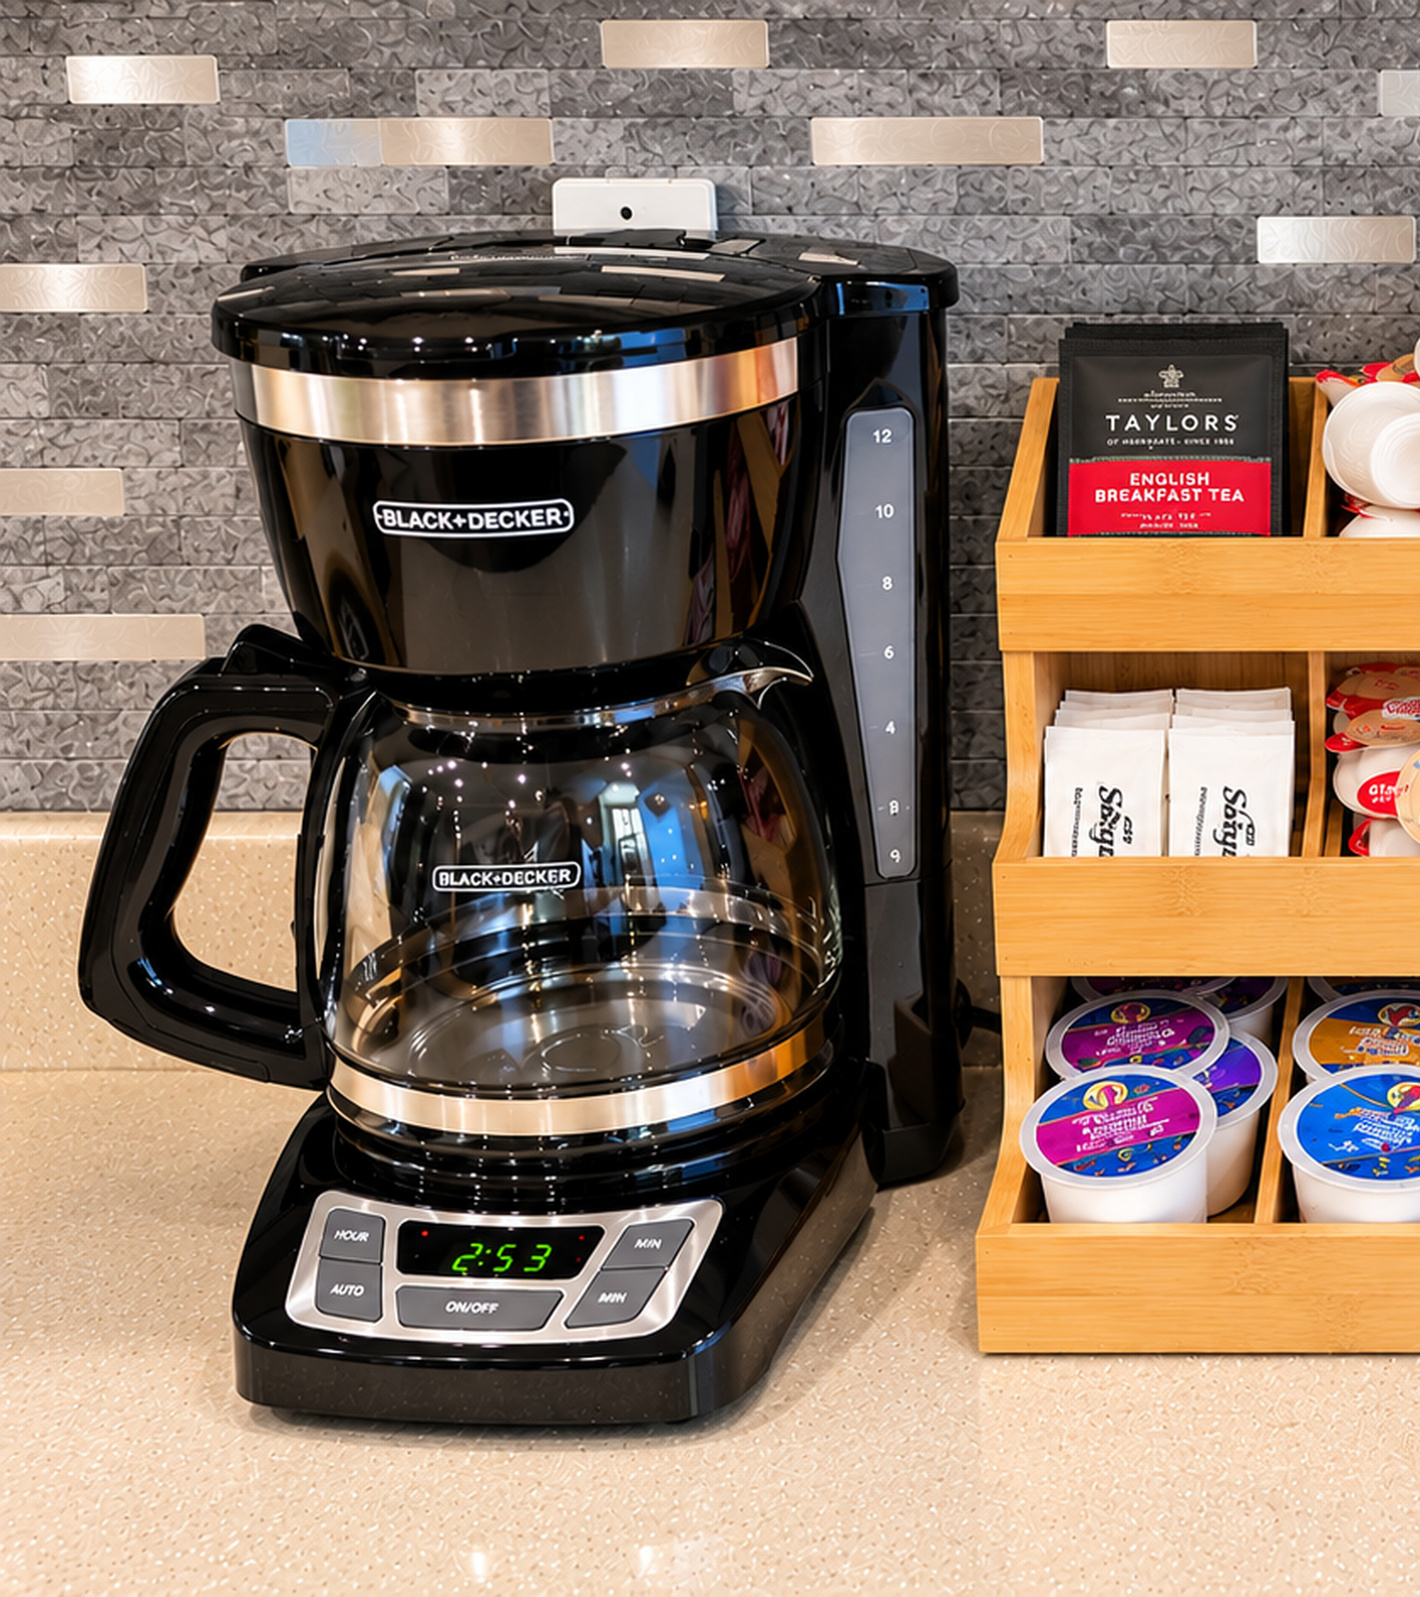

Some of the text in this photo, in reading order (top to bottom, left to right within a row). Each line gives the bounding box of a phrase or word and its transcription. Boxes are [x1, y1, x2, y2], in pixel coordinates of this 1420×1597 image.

[1105, 414, 1238, 431] TAYLORS
[872, 429, 892, 443] 12
[1130, 472, 1209, 486] ENGLISH
[1095, 488, 1244, 503] BREAKFAST TEA
[875, 504, 894, 518] 10
[382, 507, 563, 530] BLACK+DECKER
[882, 576, 893, 590] 8
[884, 645, 894, 659] 6
[885, 721, 896, 734] 4
[438, 868, 571, 887] BLACK+DECKER
[334, 1230, 369, 1242] HOUR
[634, 1238, 662, 1249] MIN
[452, 1243, 552, 1272] 2:53
[330, 1284, 364, 1297] AUTO
[446, 1301, 499, 1313] ON/OFF
